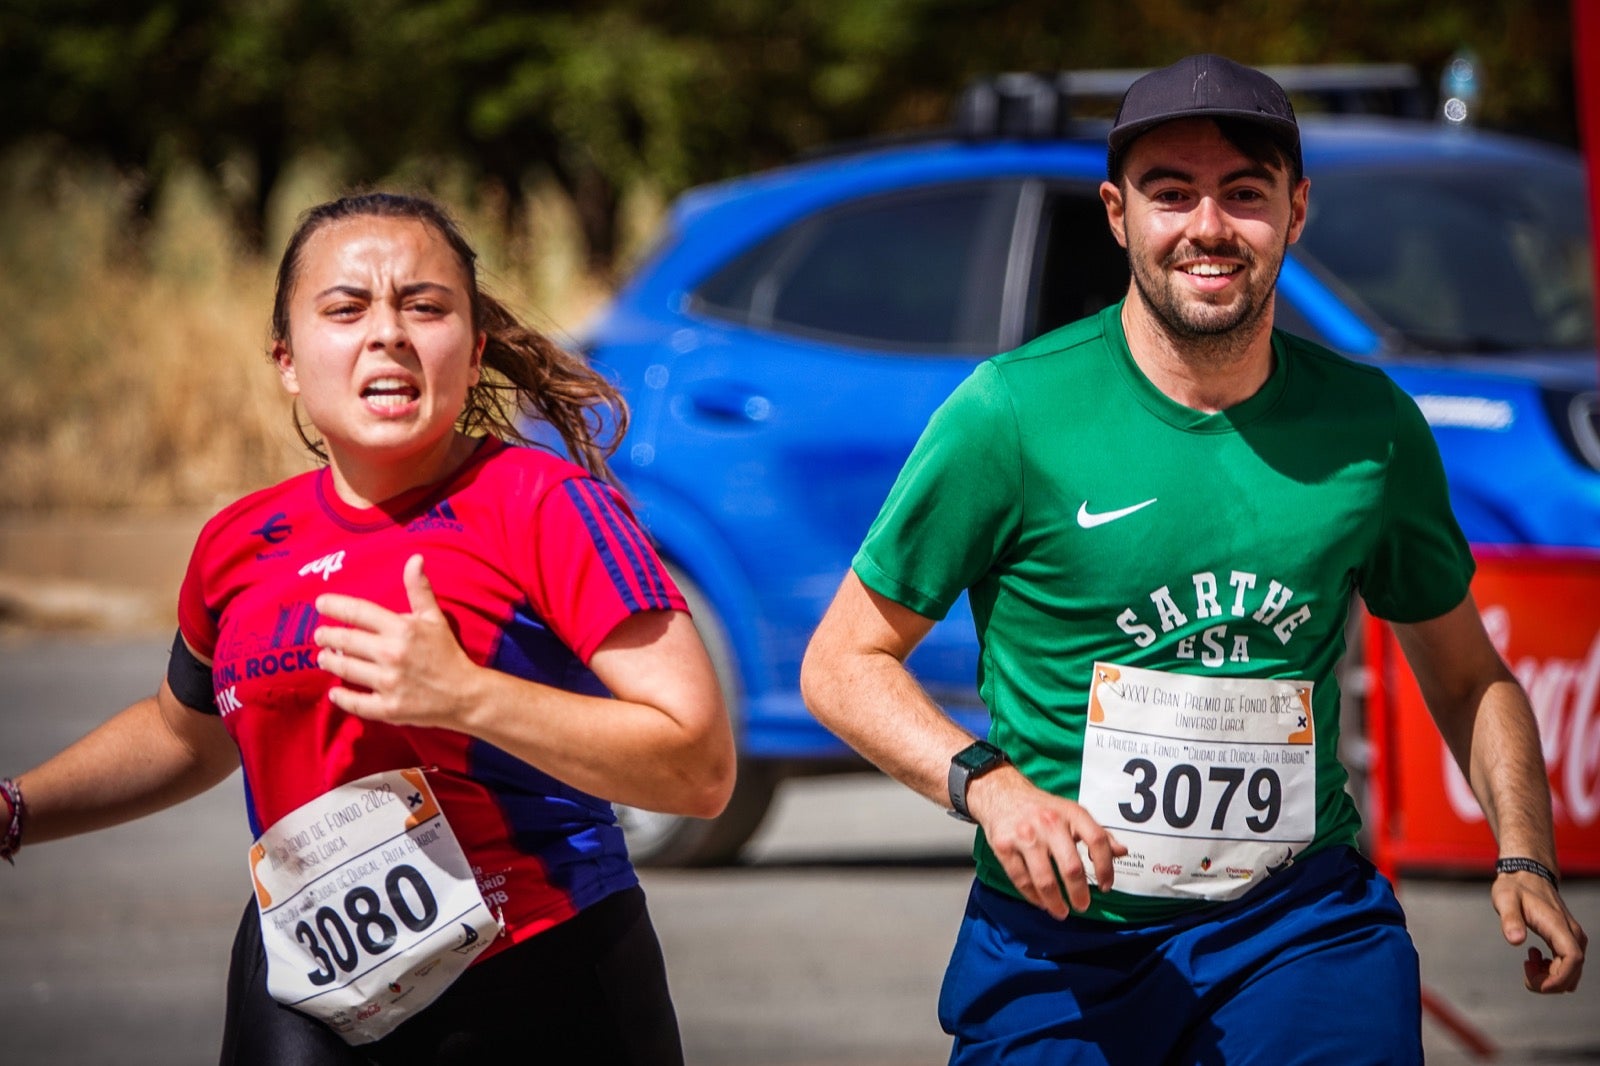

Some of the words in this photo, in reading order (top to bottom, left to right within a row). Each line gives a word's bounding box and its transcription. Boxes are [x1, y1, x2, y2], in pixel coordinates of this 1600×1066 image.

[1116, 570, 1311, 648] SARTHE
[1176, 624, 1250, 668] ESA
[1121, 683, 1149, 705] XXXV
[1270, 695, 1292, 714] 2022
[360, 783, 396, 812] 2022
[1118, 757, 1282, 834] 3079
[295, 864, 439, 986] 3080
